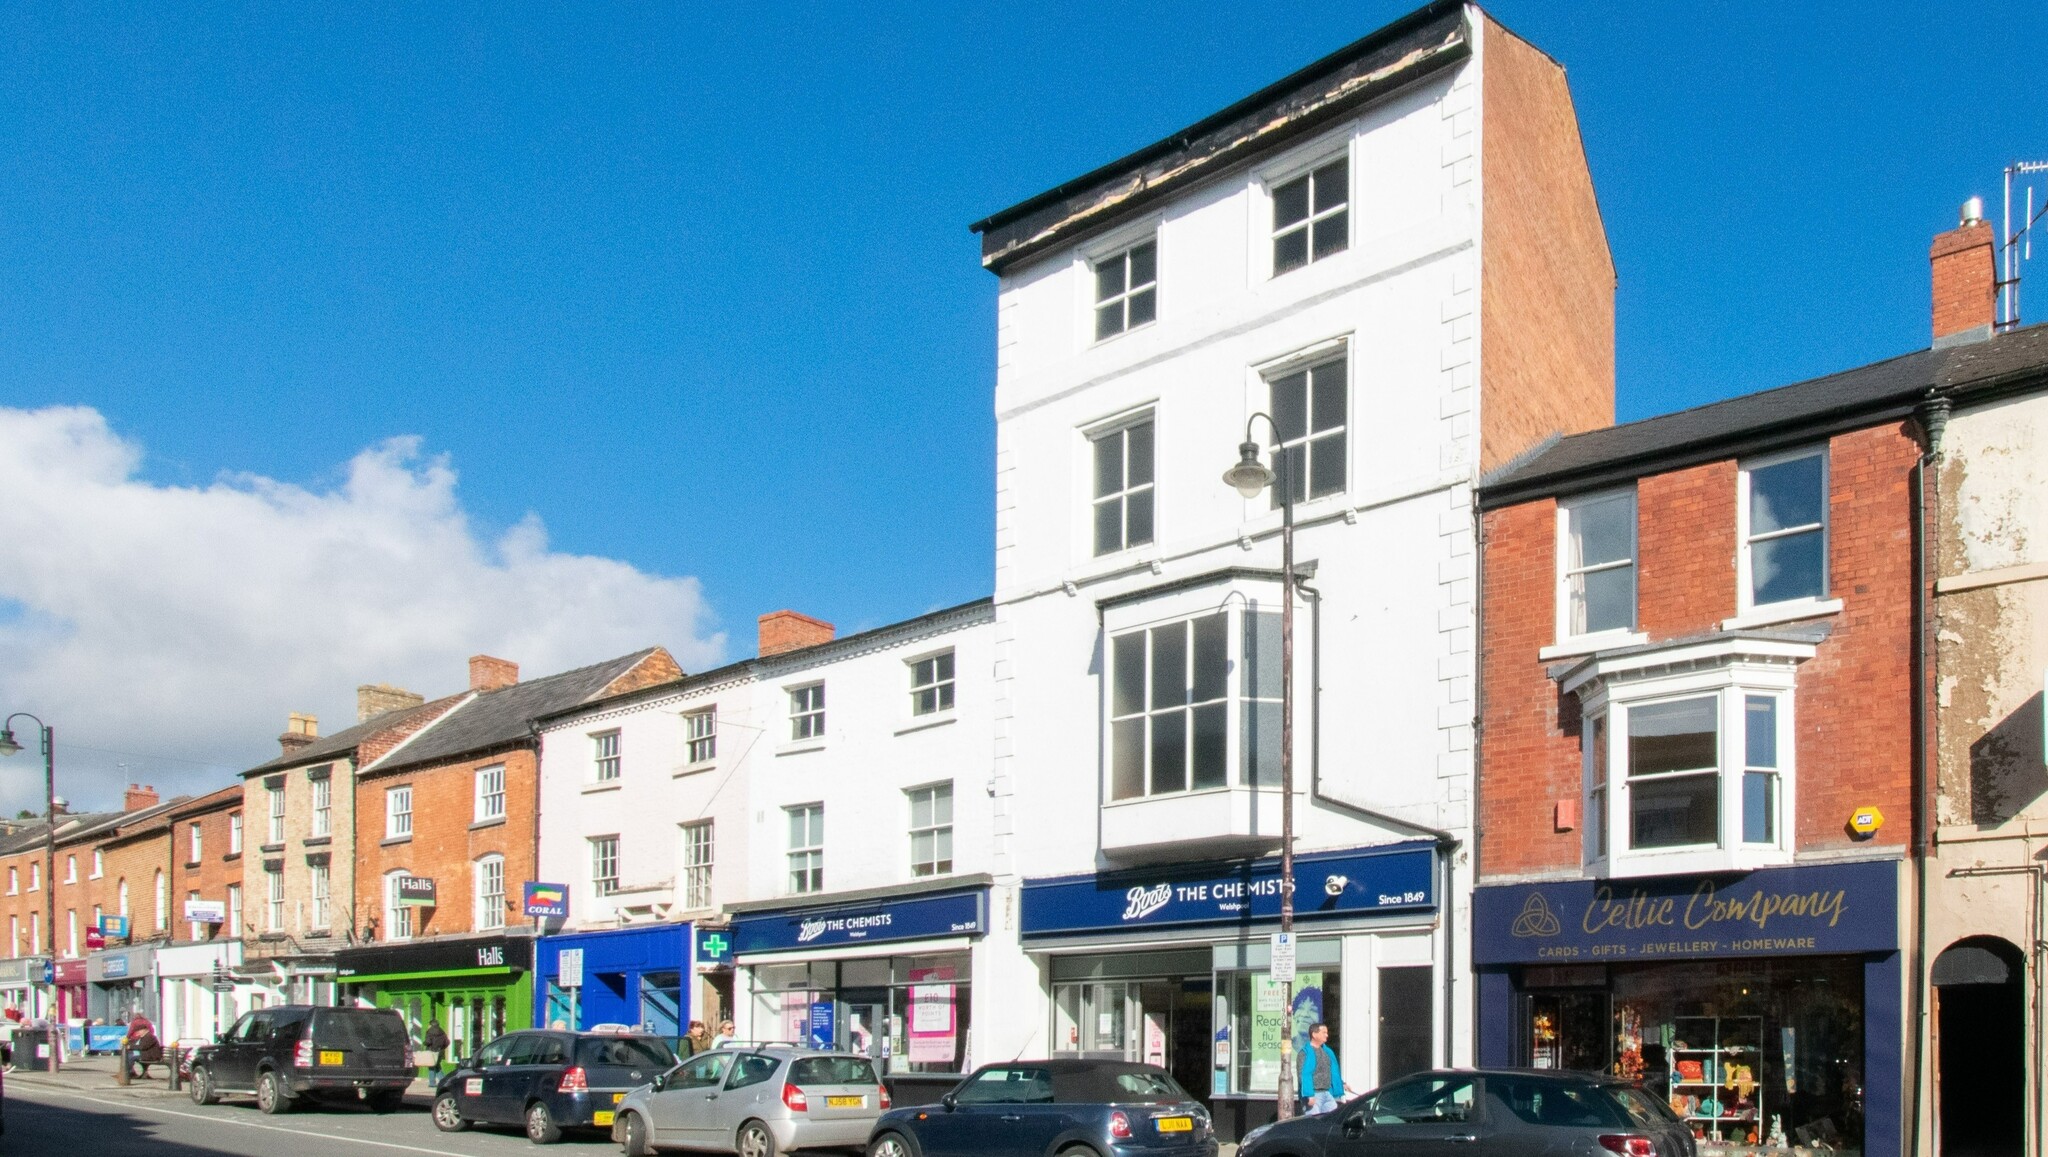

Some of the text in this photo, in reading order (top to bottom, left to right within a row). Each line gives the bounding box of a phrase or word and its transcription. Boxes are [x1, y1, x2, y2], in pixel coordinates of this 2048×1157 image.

[401, 878, 432, 891] Halls
[1122, 882, 1172, 920] Boots
[1177, 885, 1207, 902] THE
[1379, 891, 1425, 905] Since 1849
[528, 906, 563, 915] CORAL
[1582, 879, 1849, 934] Celtic Company
[798, 914, 892, 942] Boots THE CHEMISTS
[951, 923, 965, 931] Since
[1538, 946, 1579, 958] CARDS
[1592, 944, 1627, 956] GIFTS
[1640, 941, 1718, 954] JEWELLERY
[1732, 937, 1816, 951] HOMEWARE
[478, 946, 504, 966] Halls
[1256, 1015, 1282, 1026] Rea
[1262, 1032, 1274, 1041] flu
[1257, 1041, 1282, 1050] seaso
